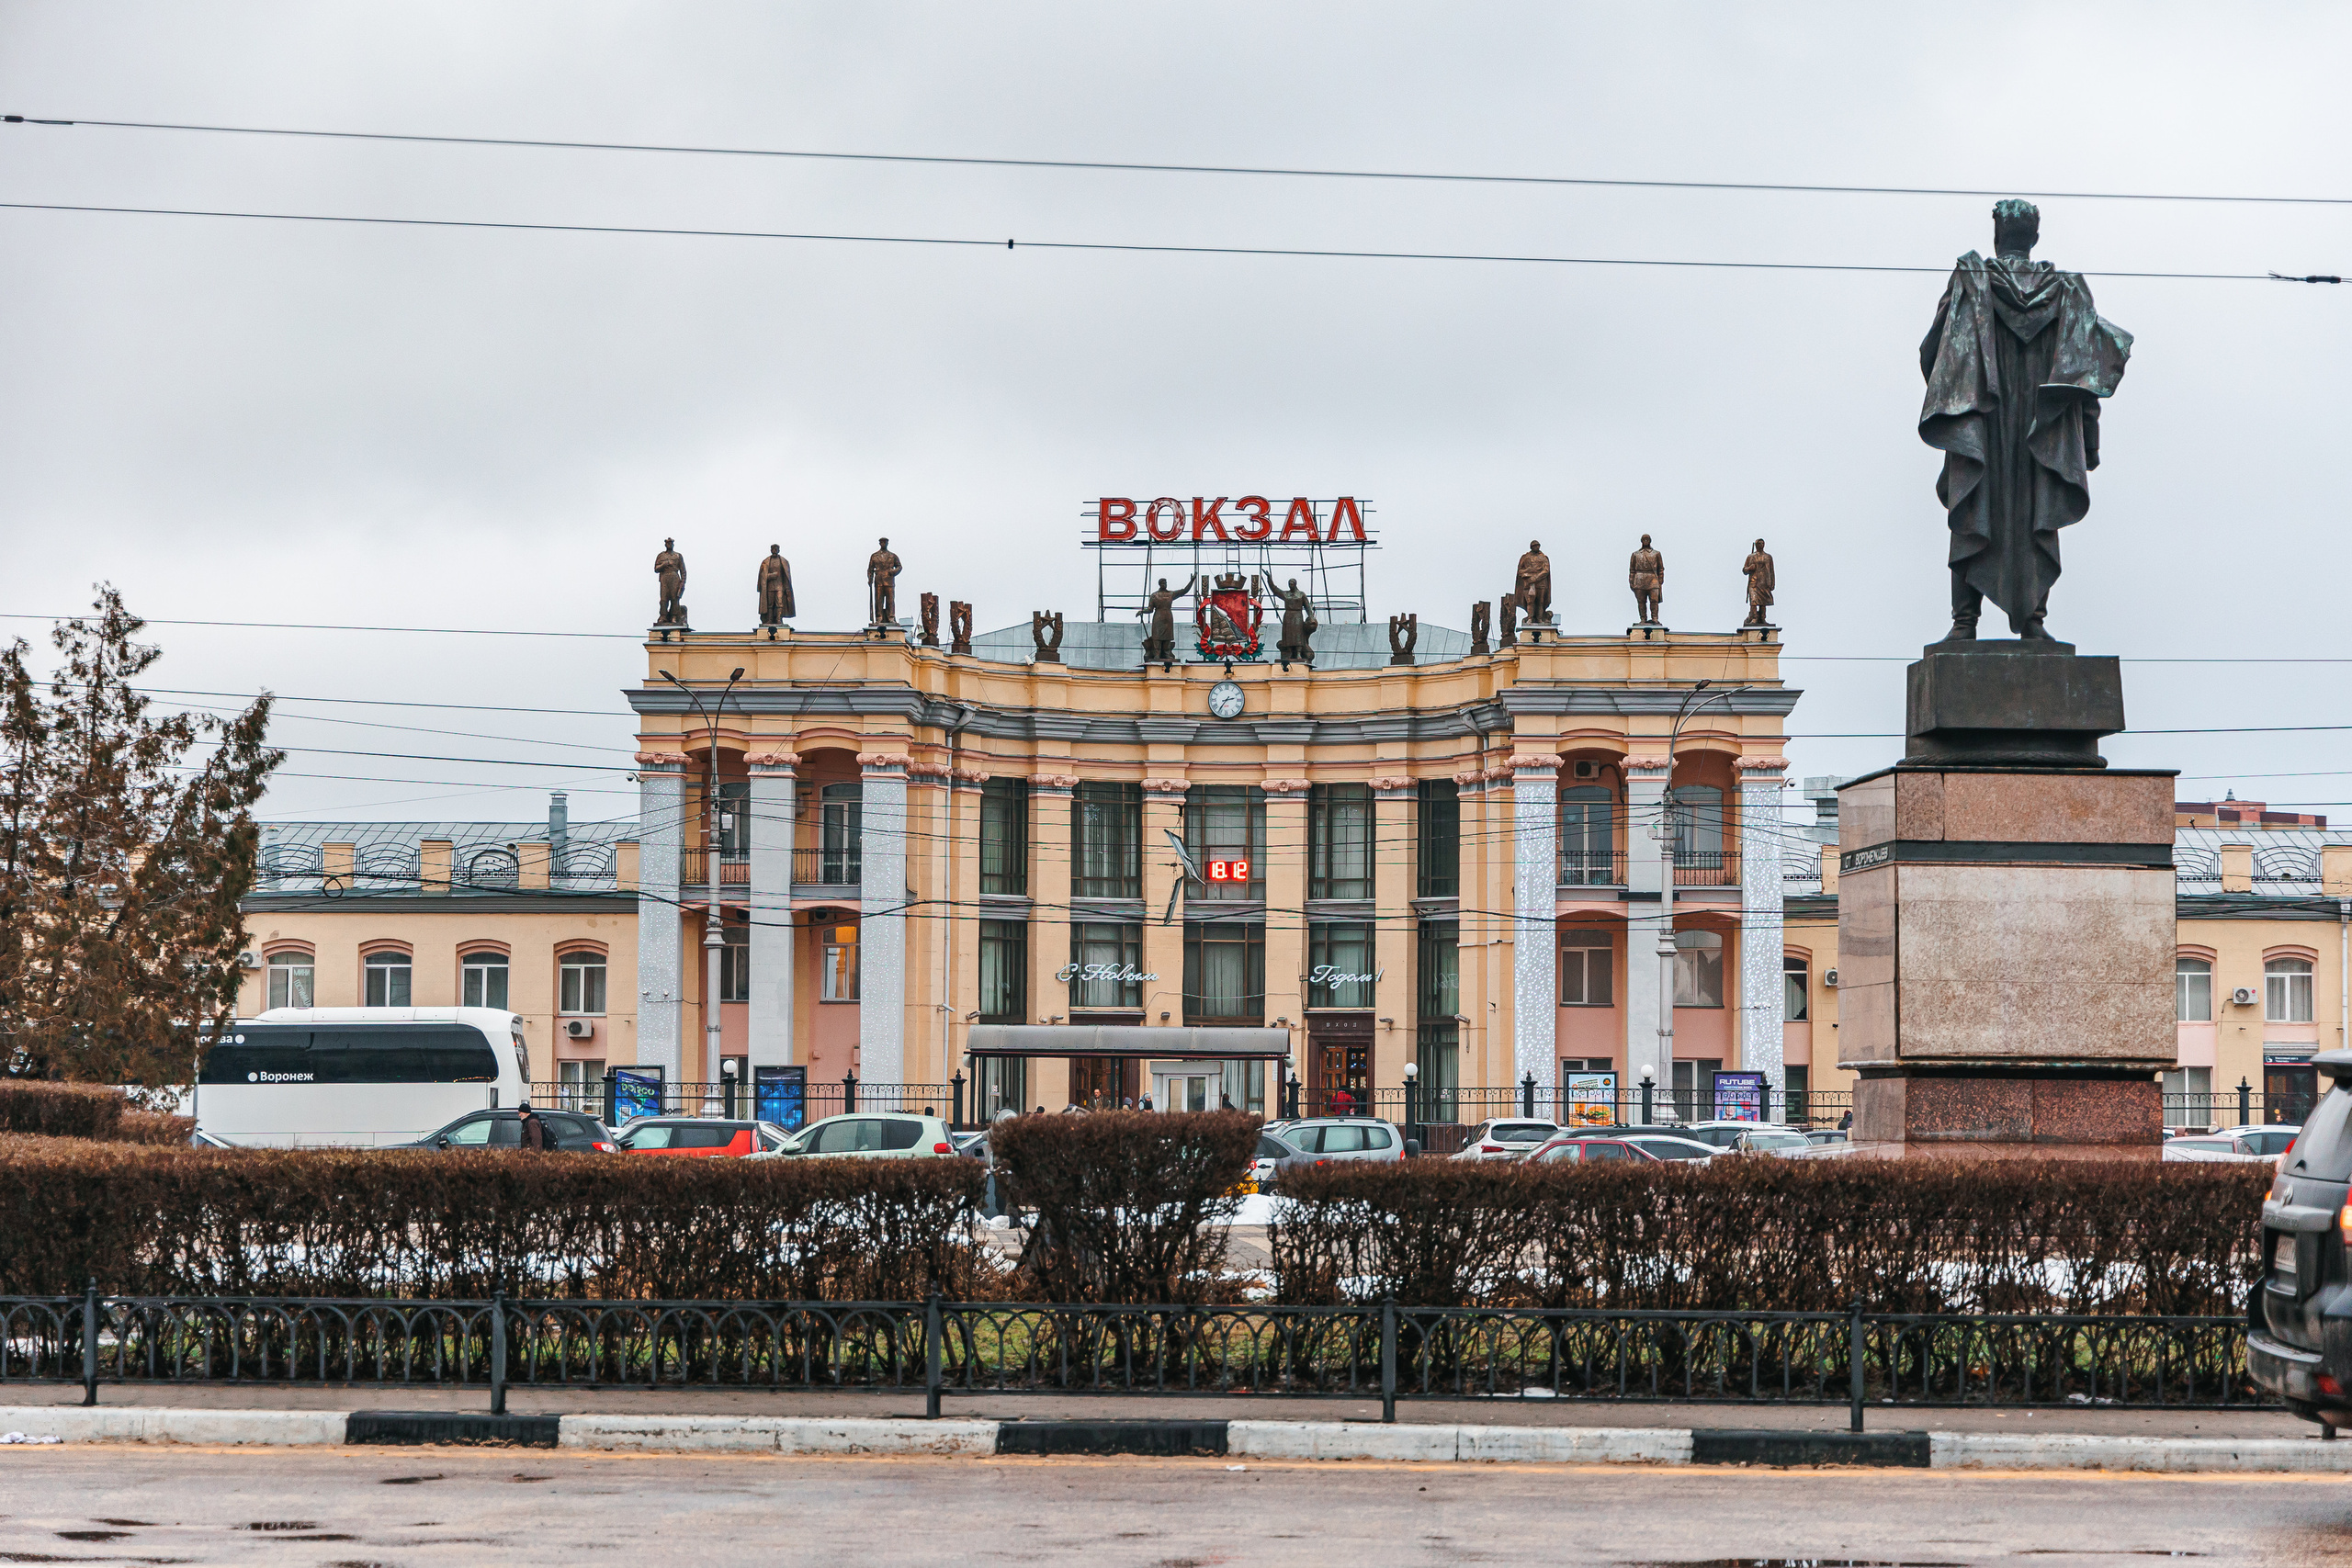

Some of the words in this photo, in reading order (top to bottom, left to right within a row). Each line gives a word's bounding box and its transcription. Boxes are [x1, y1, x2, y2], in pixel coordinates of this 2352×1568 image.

[1099, 495, 1368, 542] ВОКЗАЛ
[293, 968, 311, 976] МИНИ
[1057, 963, 1079, 982] С
[1081, 963, 1159, 982] Новым
[260, 1071, 314, 1083] Воронеж
